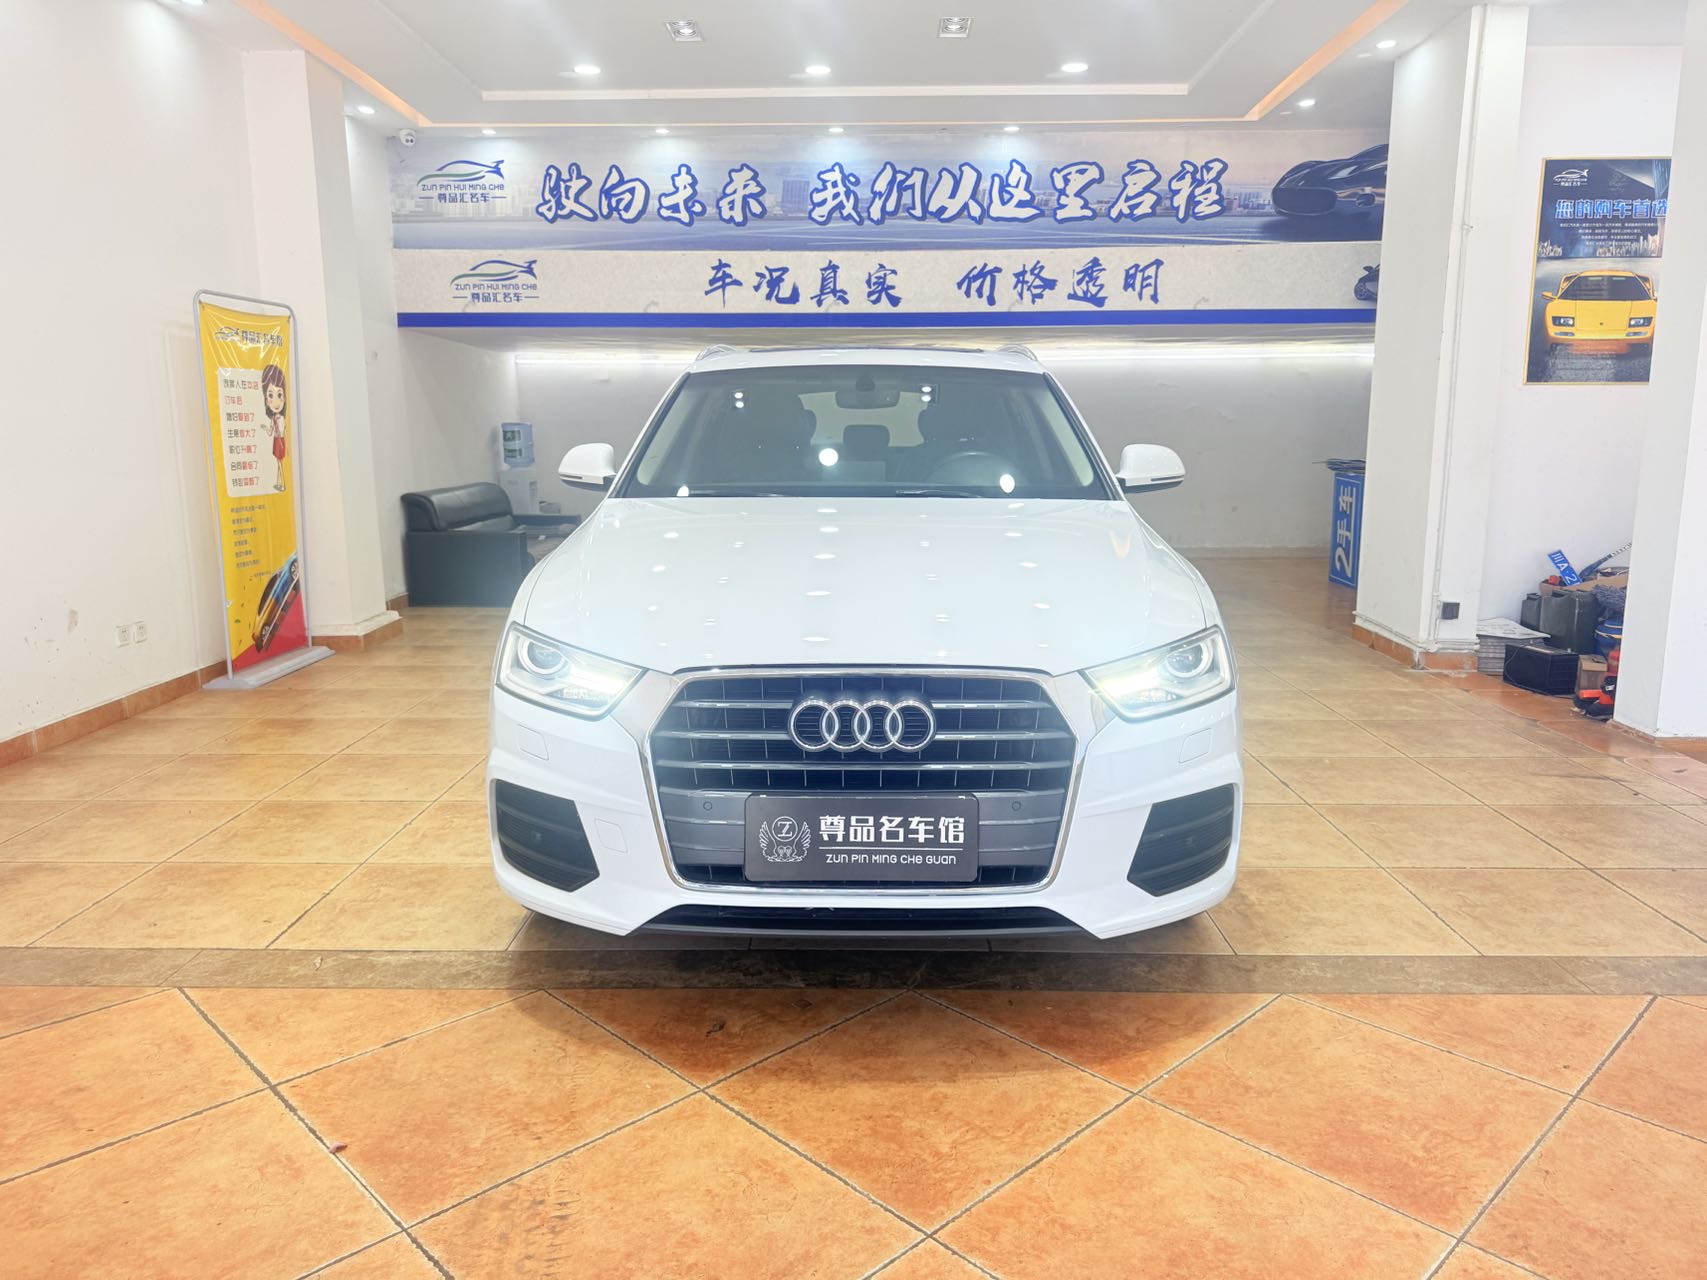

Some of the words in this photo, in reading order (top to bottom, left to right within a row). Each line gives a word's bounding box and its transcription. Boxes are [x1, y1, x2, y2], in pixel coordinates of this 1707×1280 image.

[537, 162, 766, 227] 驶向未来
[809, 159, 1229, 226] 我们从这里启程
[704, 258, 902, 308] 车况真实
[957, 256, 1164, 308] 价格透明
[1335, 485, 1356, 578] 2手车
[818, 815, 965, 844] 尊品名车馆
